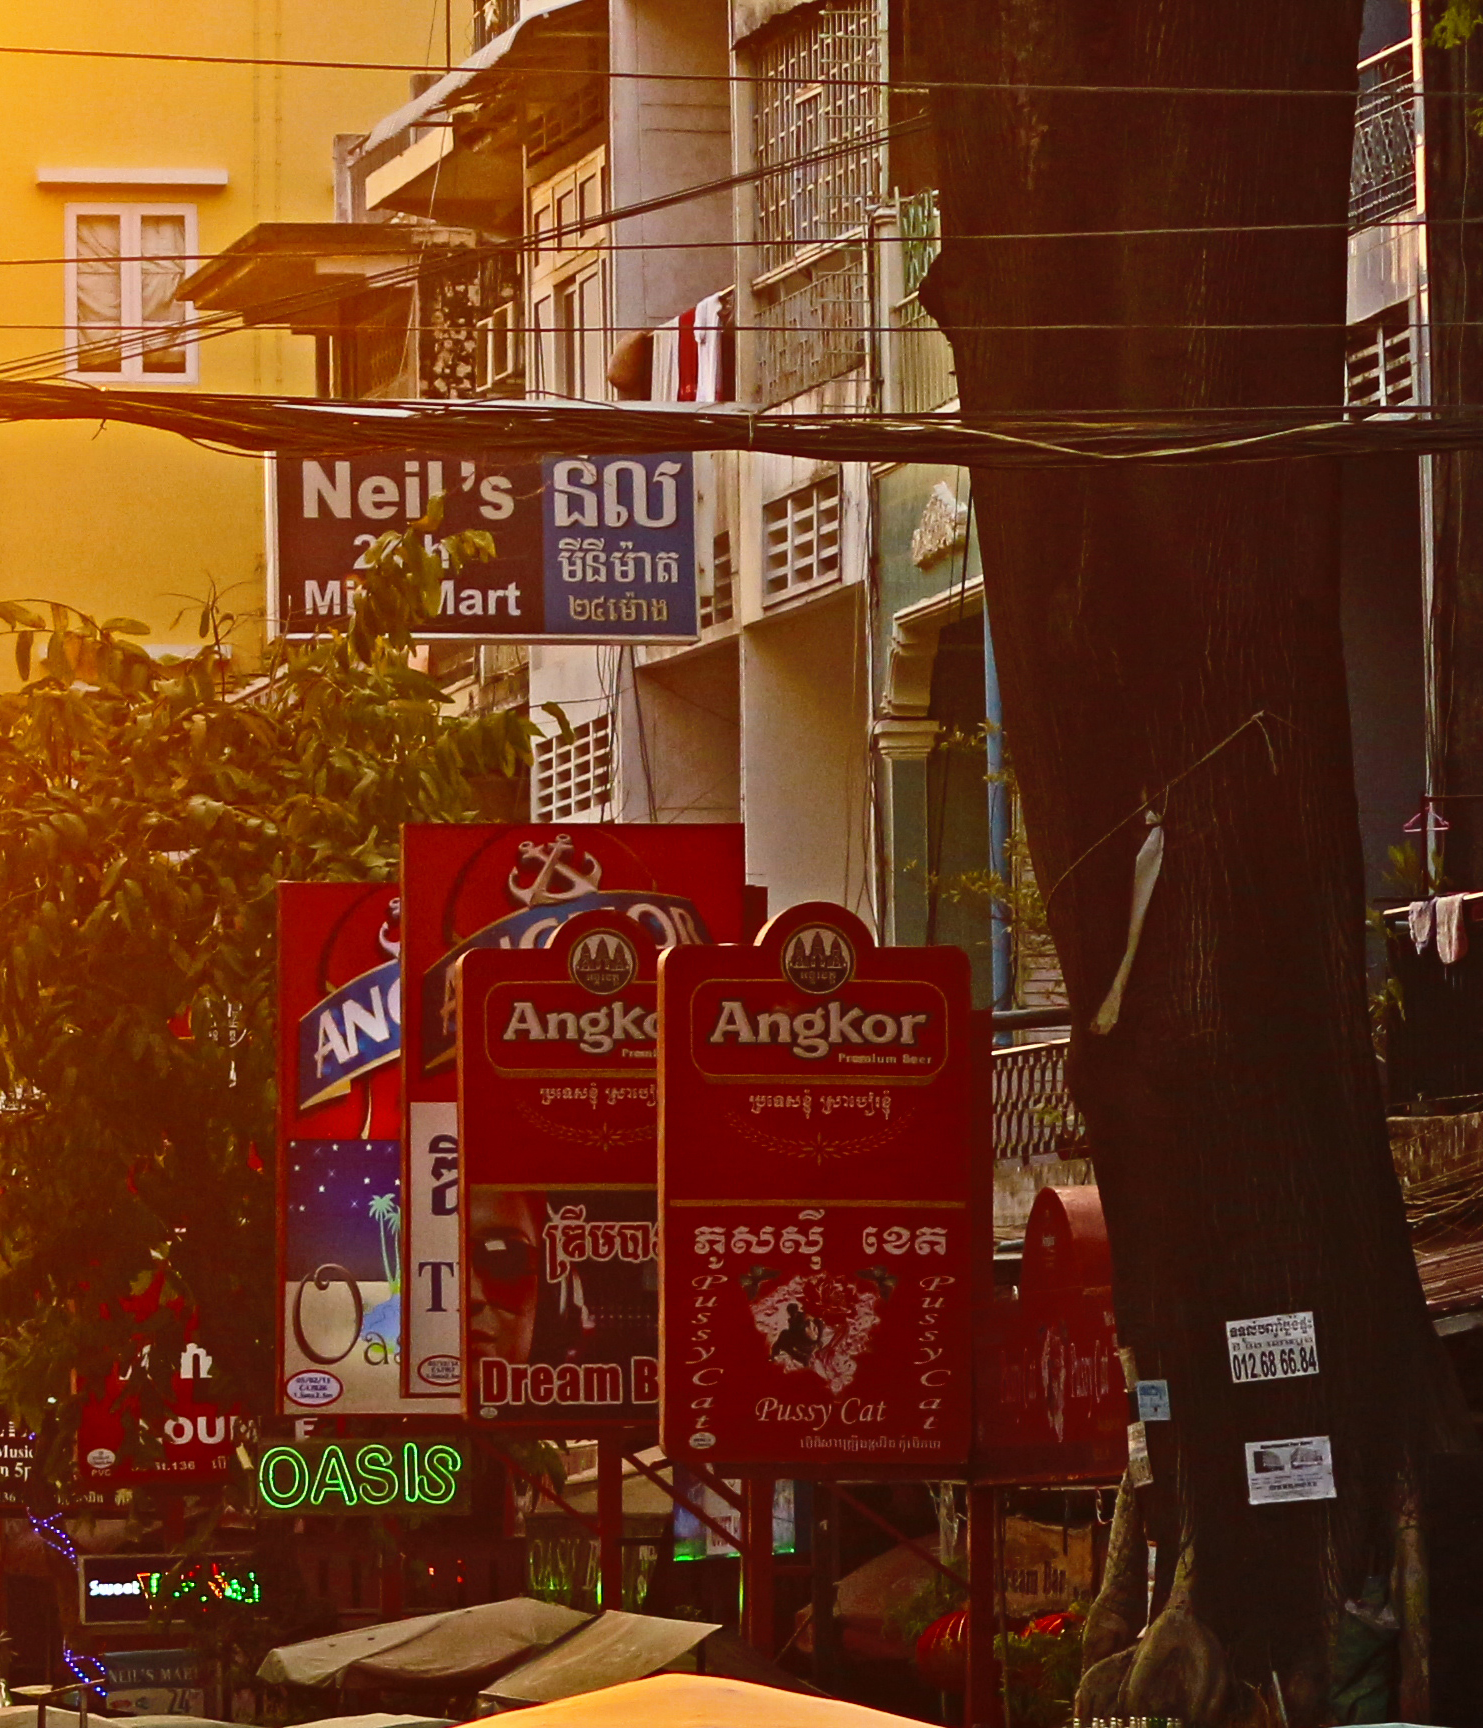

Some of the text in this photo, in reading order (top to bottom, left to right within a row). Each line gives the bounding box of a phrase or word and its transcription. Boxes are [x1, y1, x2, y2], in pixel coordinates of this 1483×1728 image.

[302, 461, 515, 519] Neil's
[709, 1002, 928, 1059] Angkor
[479, 1358, 624, 1406] Dream
[755, 1397, 886, 1431] Pussy Cat
[259, 1442, 462, 1508] OASIS
[88, 1579, 141, 1598] Sweet
